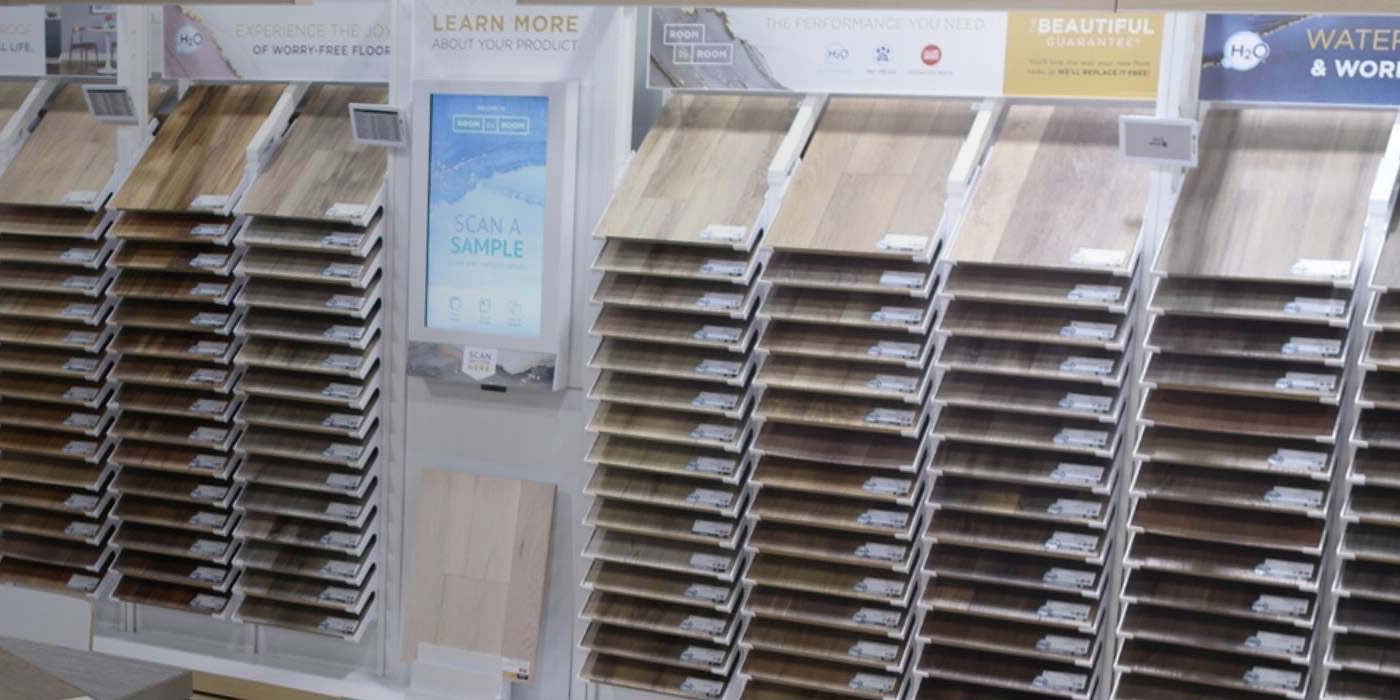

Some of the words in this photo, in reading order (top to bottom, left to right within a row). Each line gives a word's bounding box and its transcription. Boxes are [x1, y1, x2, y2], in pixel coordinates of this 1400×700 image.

[432, 15, 504, 32] LEARN
[514, 15, 579, 32] MORE
[766, 17, 793, 30] THE
[798, 17, 903, 31] PERFORMANCE
[909, 17, 941, 31] YOU
[946, 18, 985, 31] NEED
[1038, 17, 1155, 34] BEAUTIFUL
[236, 24, 321, 38] EXPERIENCE
[332, 24, 358, 38] THE
[669, 30, 699, 39] ROOM
[252, 45, 267, 55] OF
[273, 45, 348, 56] WORRY-FREE
[431, 38, 474, 50] ABOUT
[478, 39, 512, 51] YOUR
[516, 39, 578, 51] PRODUCT
[696, 49, 727, 58] ROOM
[1230, 44, 1267, 60] H2O
[1310, 58, 1327, 77] &
[1334, 59, 1400, 79] WOR
[455, 214, 503, 234] SCAN
[509, 217, 521, 234] A
[450, 236, 524, 258] SAMPLE
[469, 351, 492, 360] SCAN
